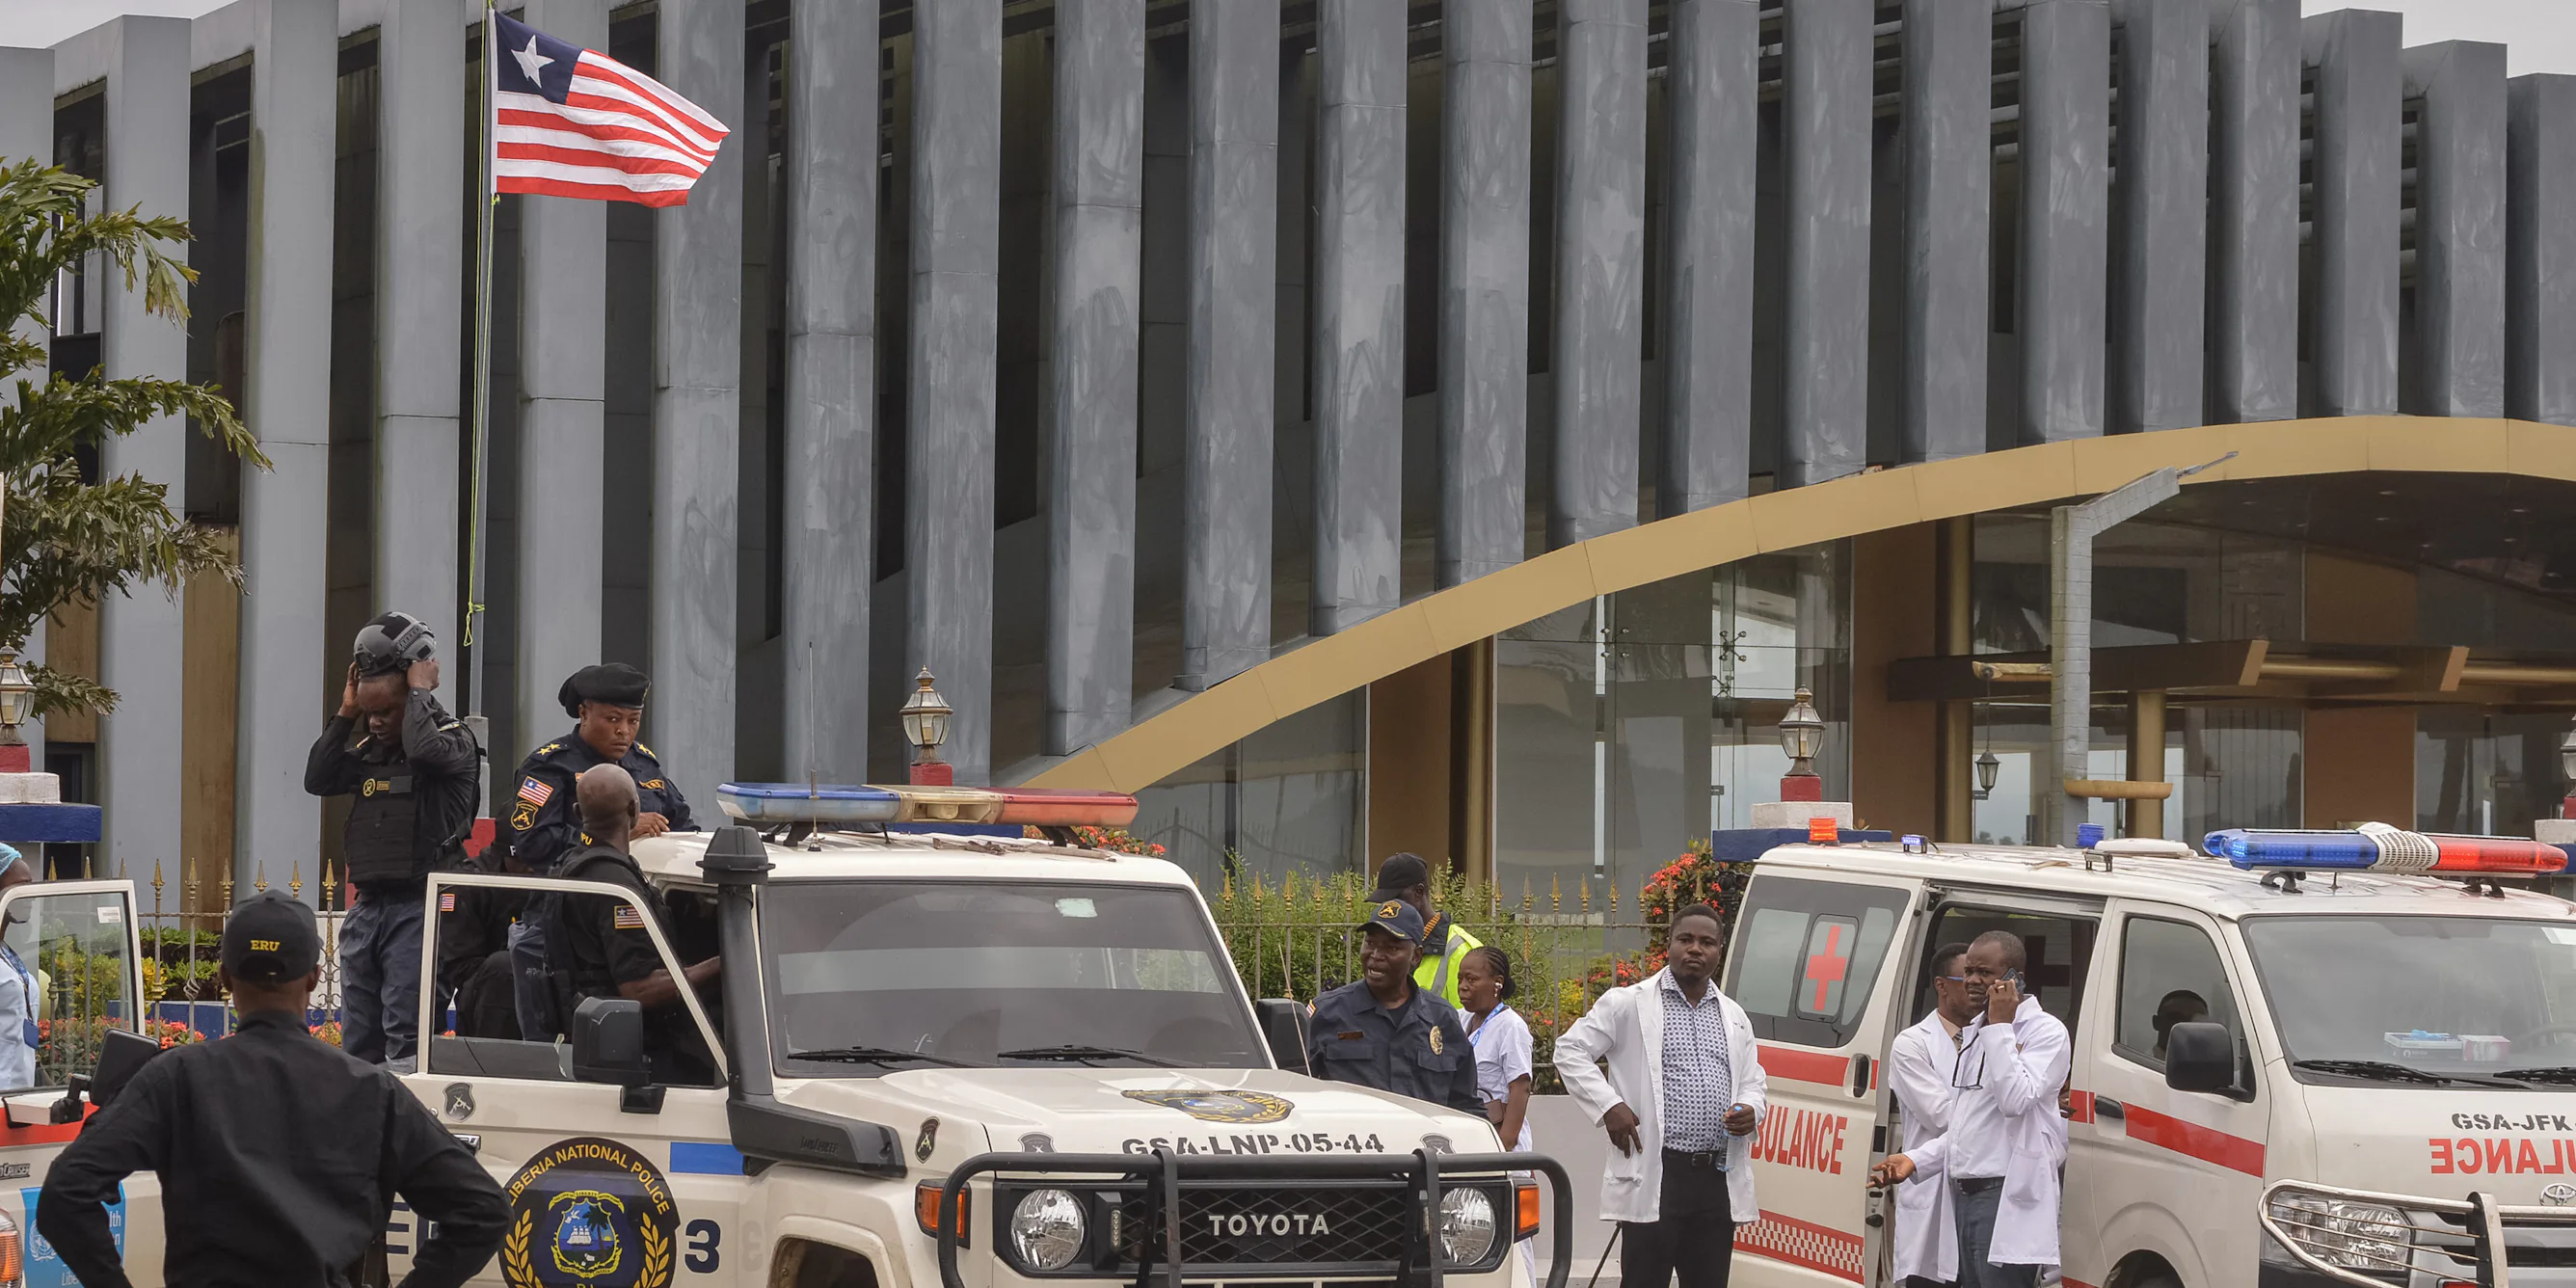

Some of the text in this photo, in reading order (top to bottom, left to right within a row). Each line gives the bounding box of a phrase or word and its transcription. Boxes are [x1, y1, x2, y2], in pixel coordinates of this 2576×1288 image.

[250, 939, 281, 952] ERU
[1751, 1105, 1848, 1175] BULANCE
[2452, 1113, 2576, 1131] GSA-JFK
[509, 1143, 670, 1216] LIBERIA NATIONAL POLICE
[1208, 1214, 1329, 1236] TOYOTA
[684, 1219, 721, 1275] 3
